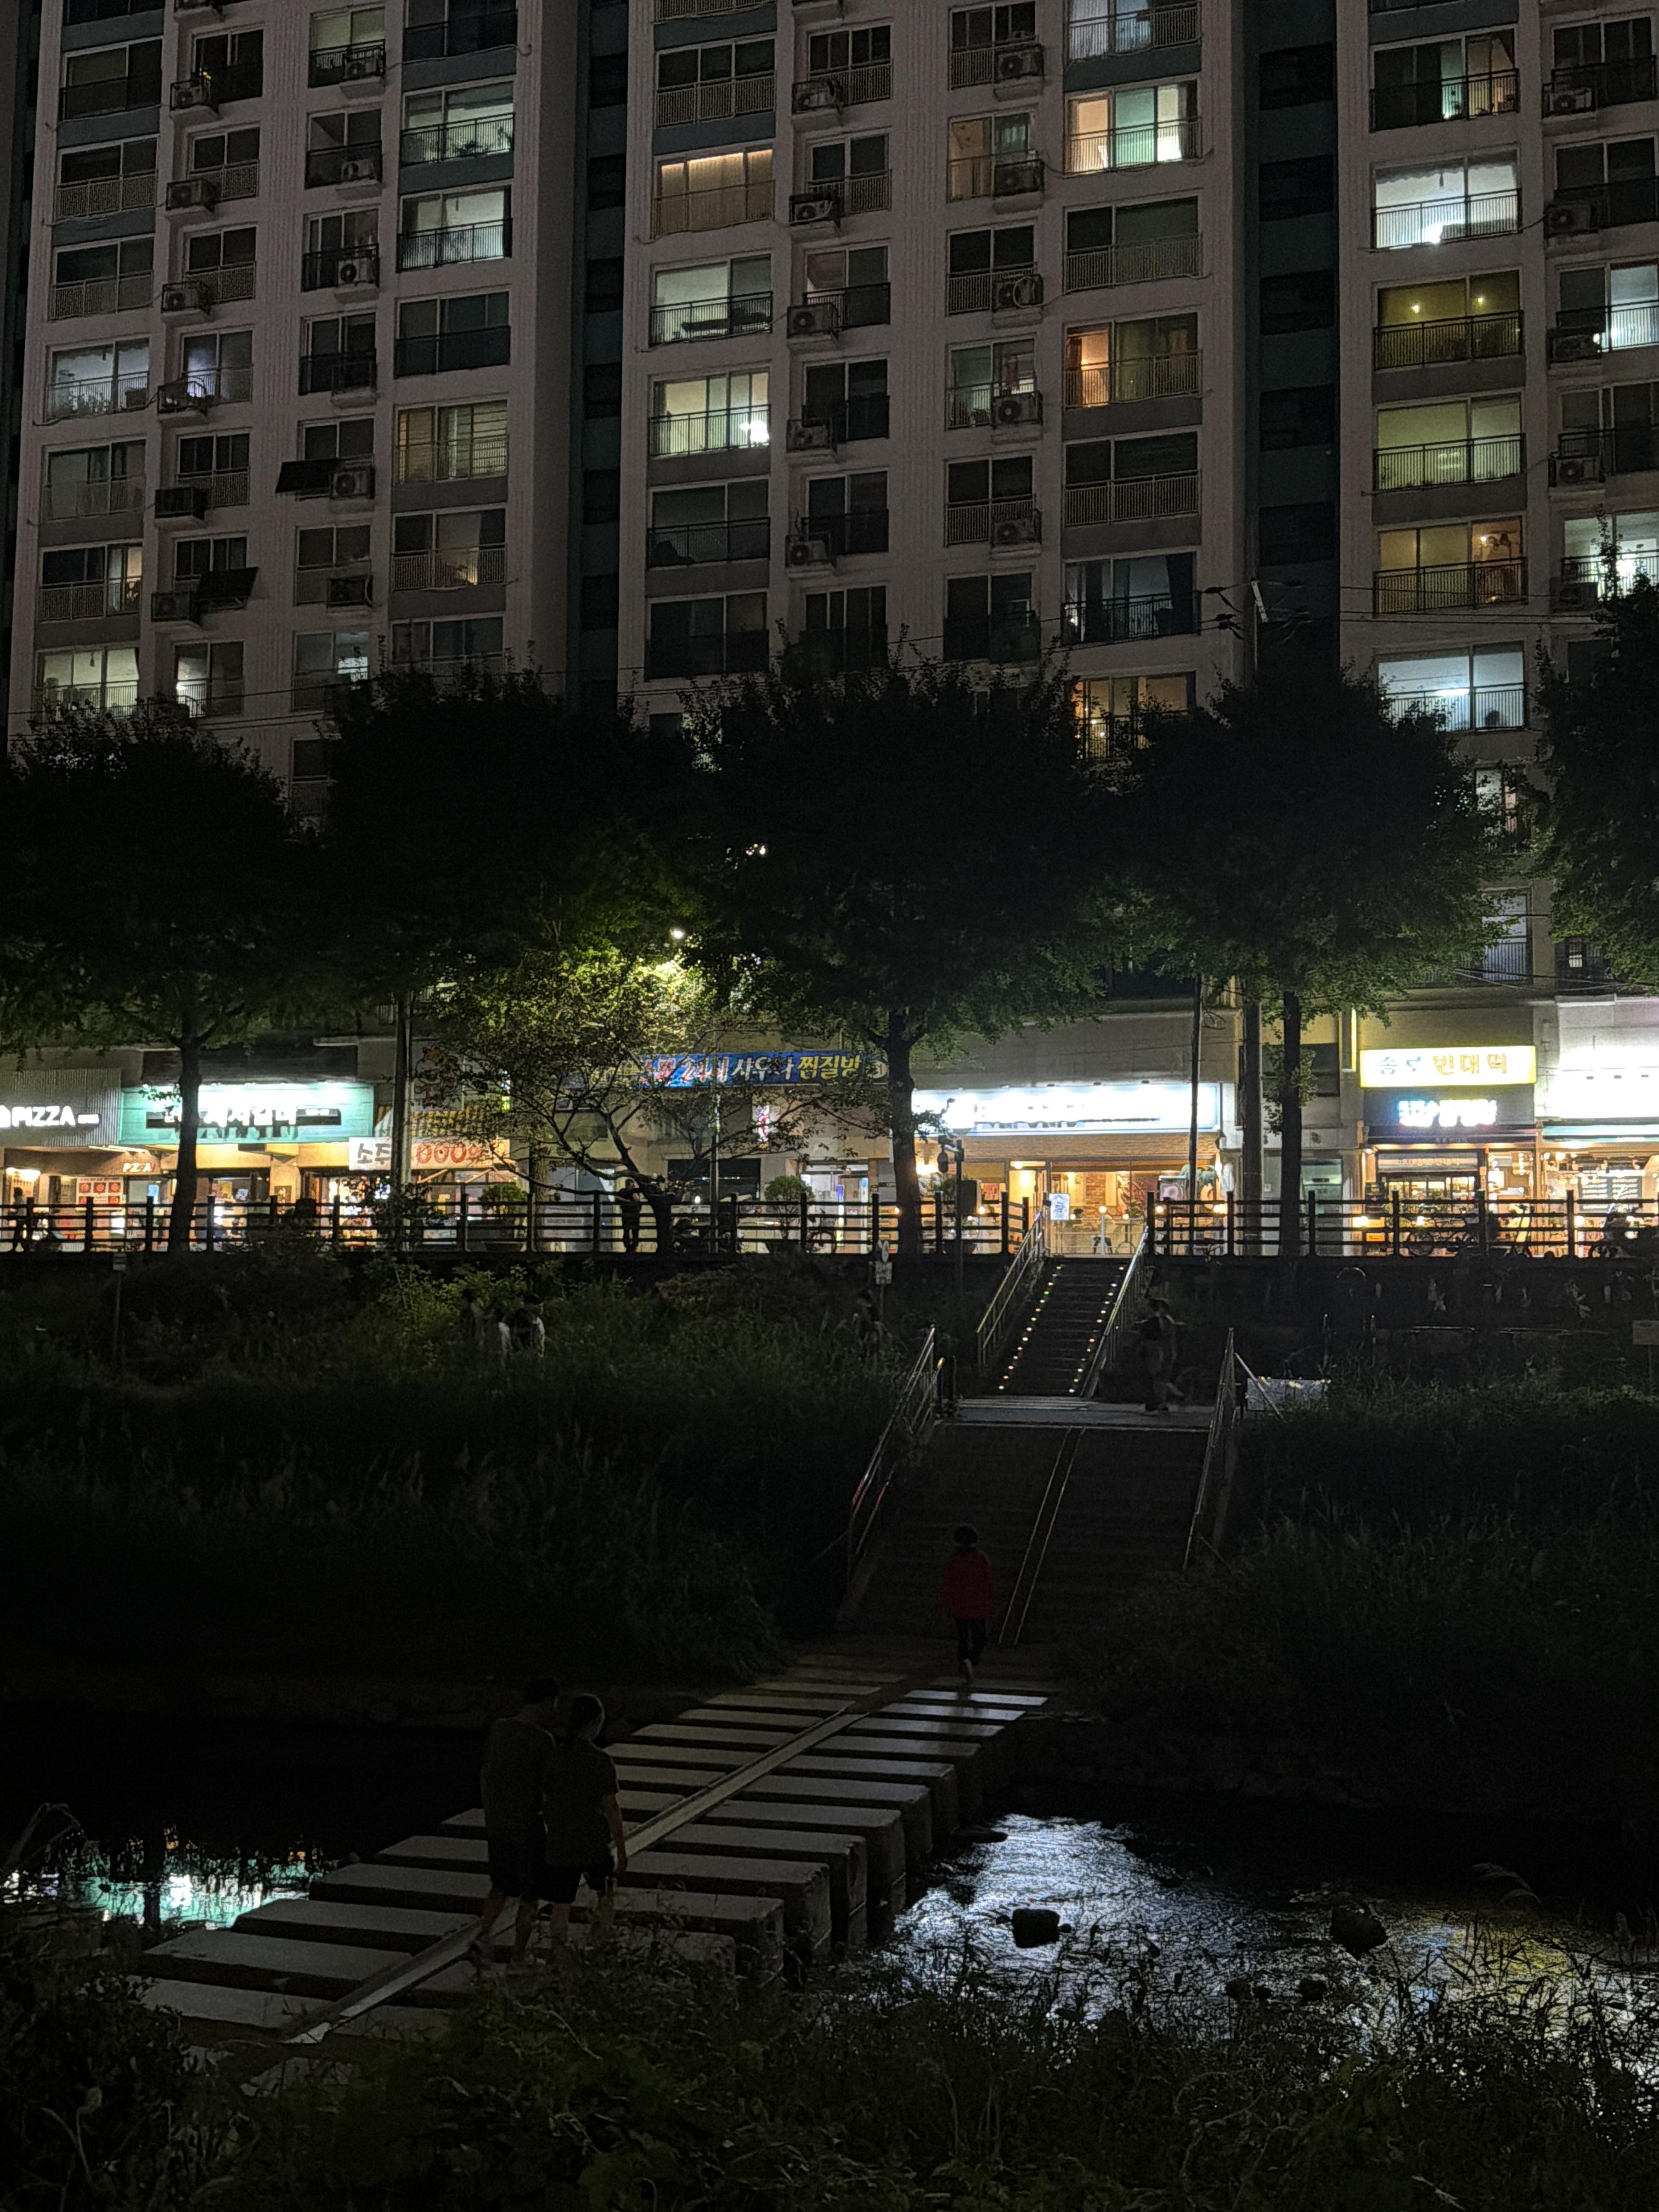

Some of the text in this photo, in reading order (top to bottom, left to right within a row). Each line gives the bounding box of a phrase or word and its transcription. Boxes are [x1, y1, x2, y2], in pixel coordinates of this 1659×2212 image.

[798, 1055, 861, 1079] 찜질방
[12, 1105, 76, 1127] PIZZA
[357, 1143, 391, 1165] 소주
